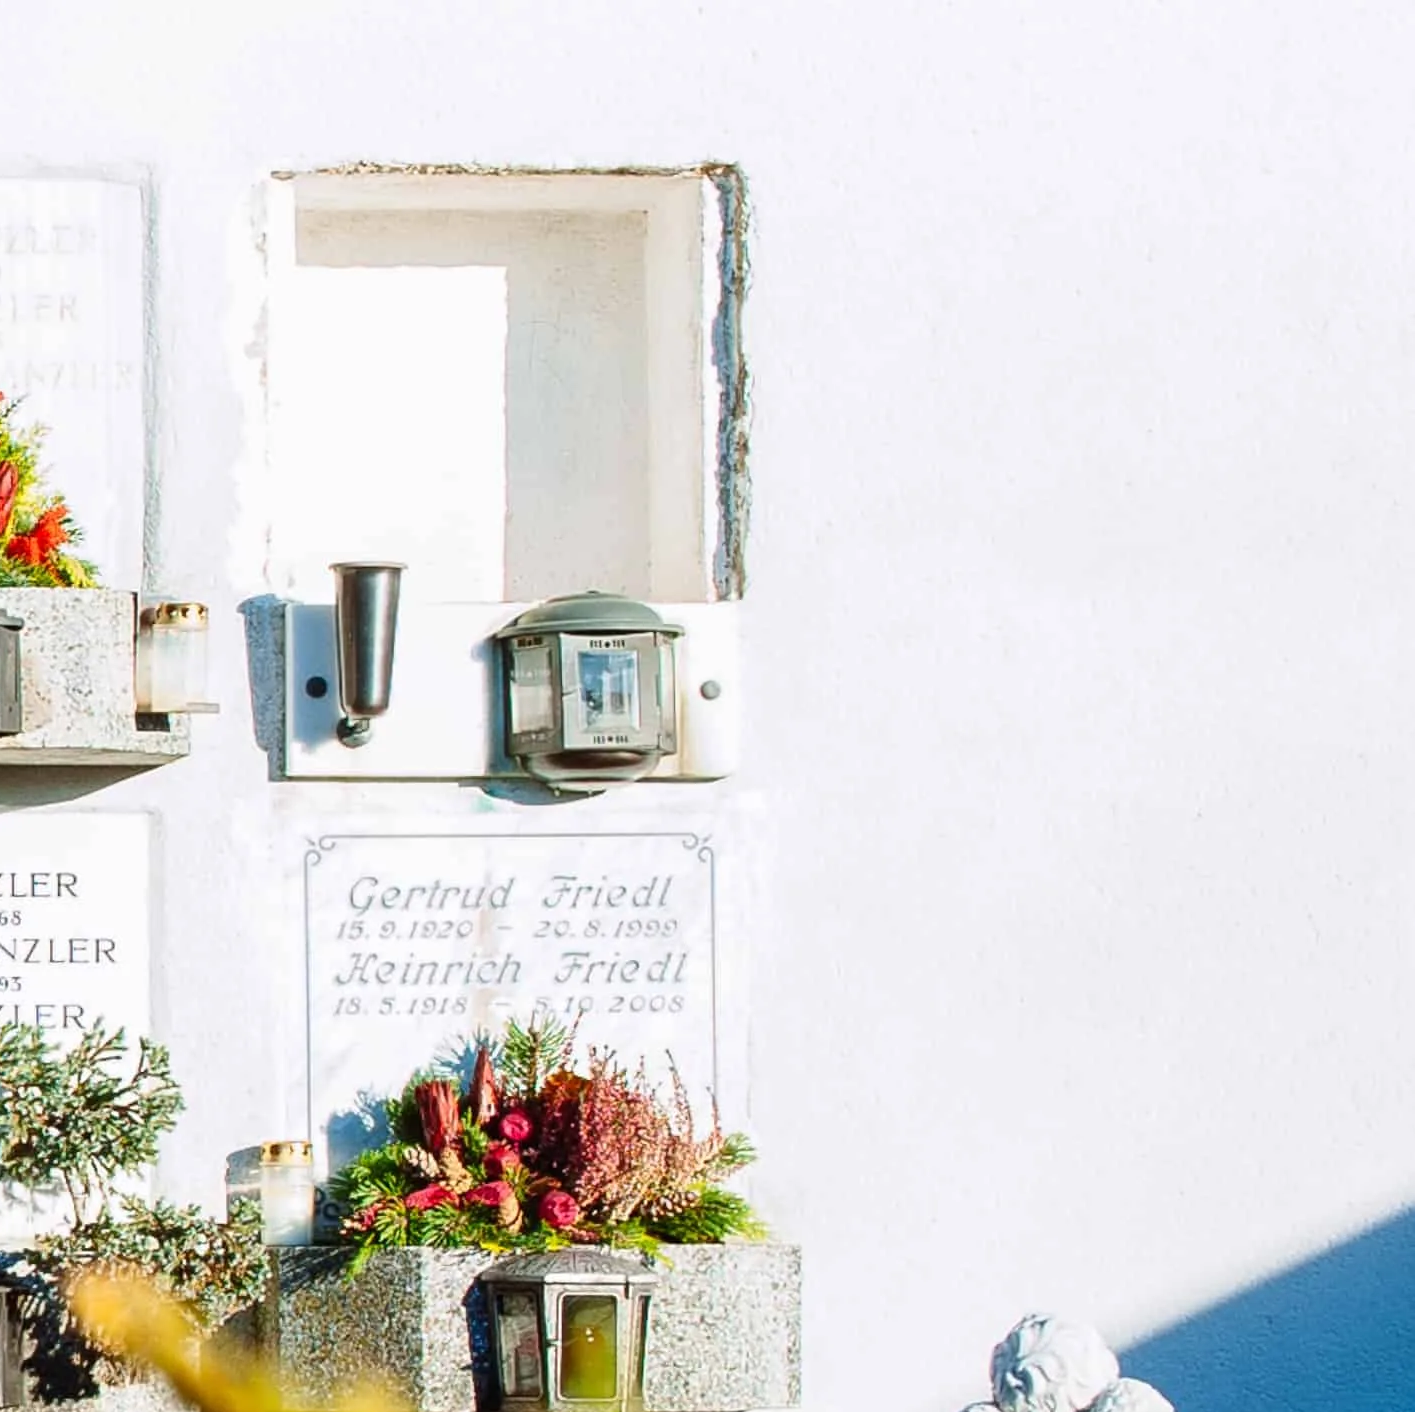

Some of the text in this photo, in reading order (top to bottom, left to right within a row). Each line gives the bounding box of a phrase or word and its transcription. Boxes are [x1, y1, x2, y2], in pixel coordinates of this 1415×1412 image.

[348, 875, 674, 915] Gertrud Friedl
[334, 951, 688, 985] Heinrich Friedl
